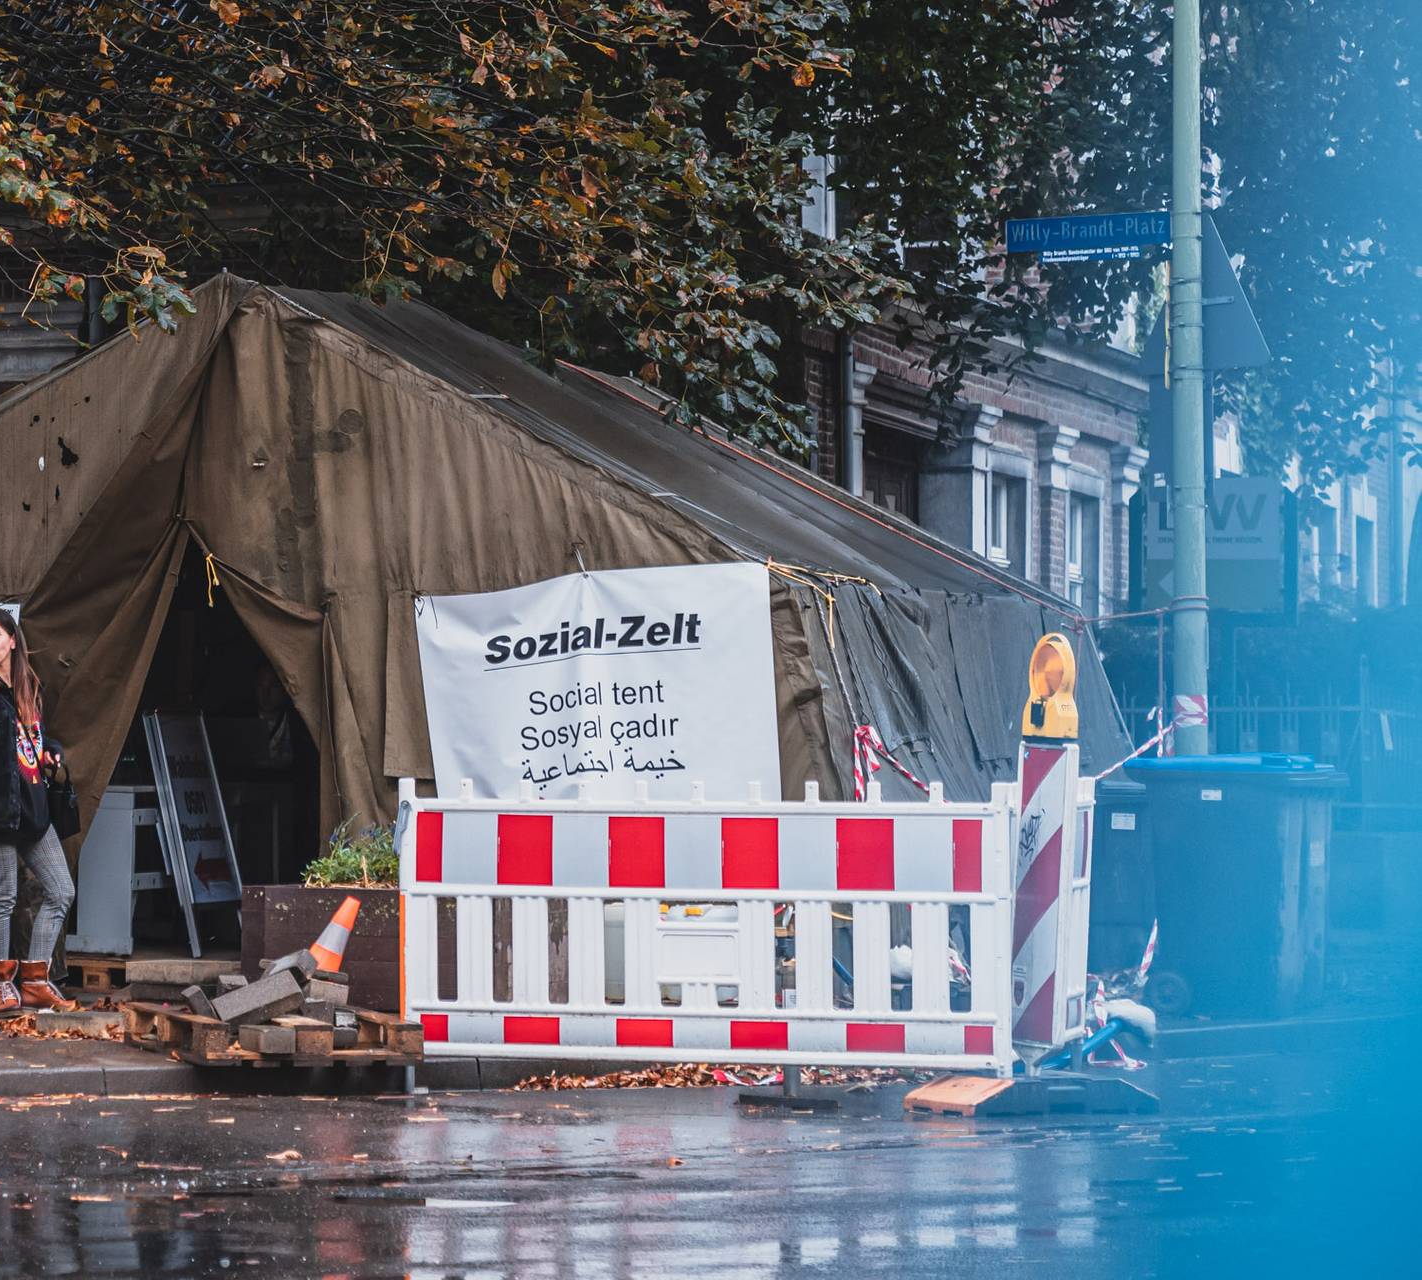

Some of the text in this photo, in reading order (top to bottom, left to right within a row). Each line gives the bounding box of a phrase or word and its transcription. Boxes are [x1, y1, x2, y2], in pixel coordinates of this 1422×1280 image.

[1011, 218, 1166, 245] Willy-Brandt-Platz
[484, 613, 702, 664] Sozial-Zelt
[529, 679, 665, 716] Social tent
[520, 713, 679, 751] Sosyal çadır
[521, 747, 686, 791] خيمة اجتماعية
